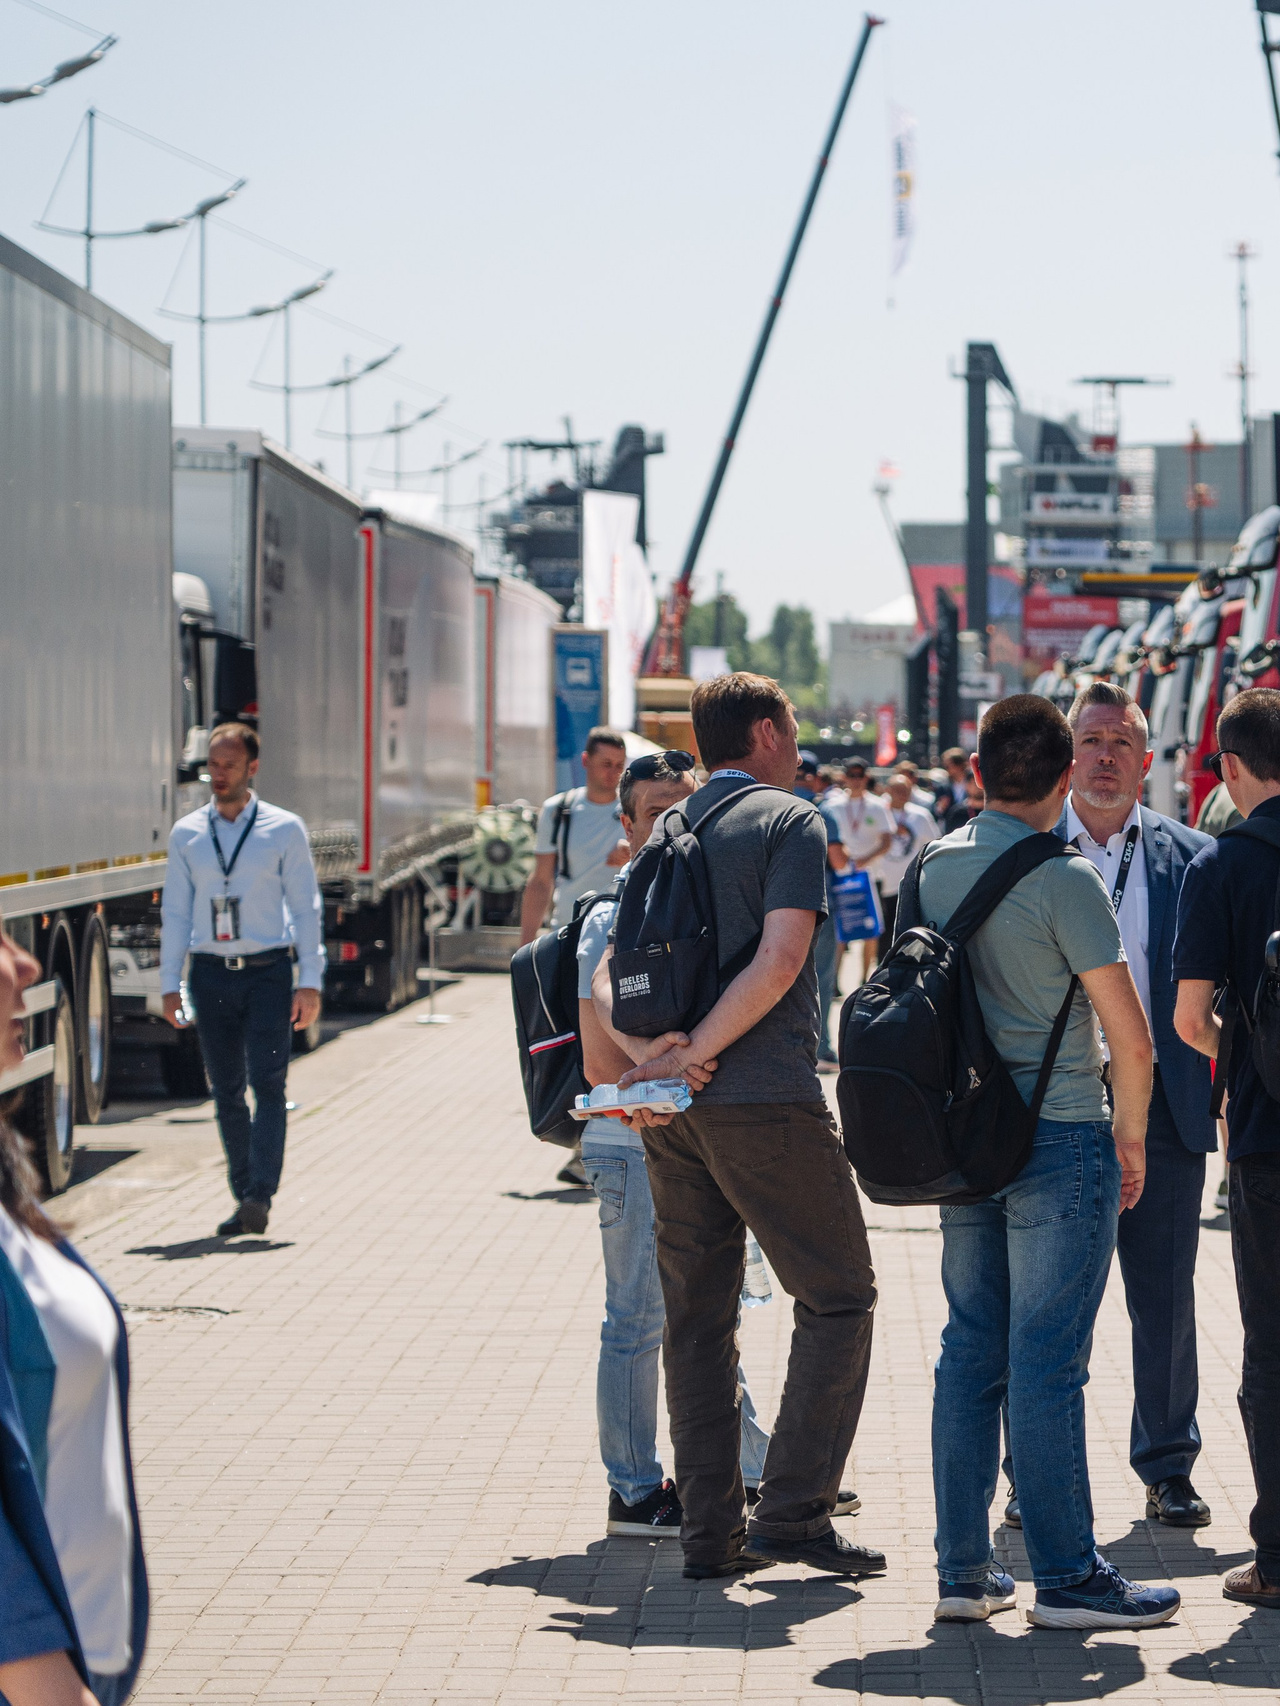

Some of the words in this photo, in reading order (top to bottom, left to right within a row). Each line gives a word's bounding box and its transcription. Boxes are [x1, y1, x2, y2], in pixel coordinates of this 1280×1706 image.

[1123, 841, 1135, 863] EXPO
[619, 973, 649, 987] WIRELESS
[619, 981, 650, 995] OVERLORDS
